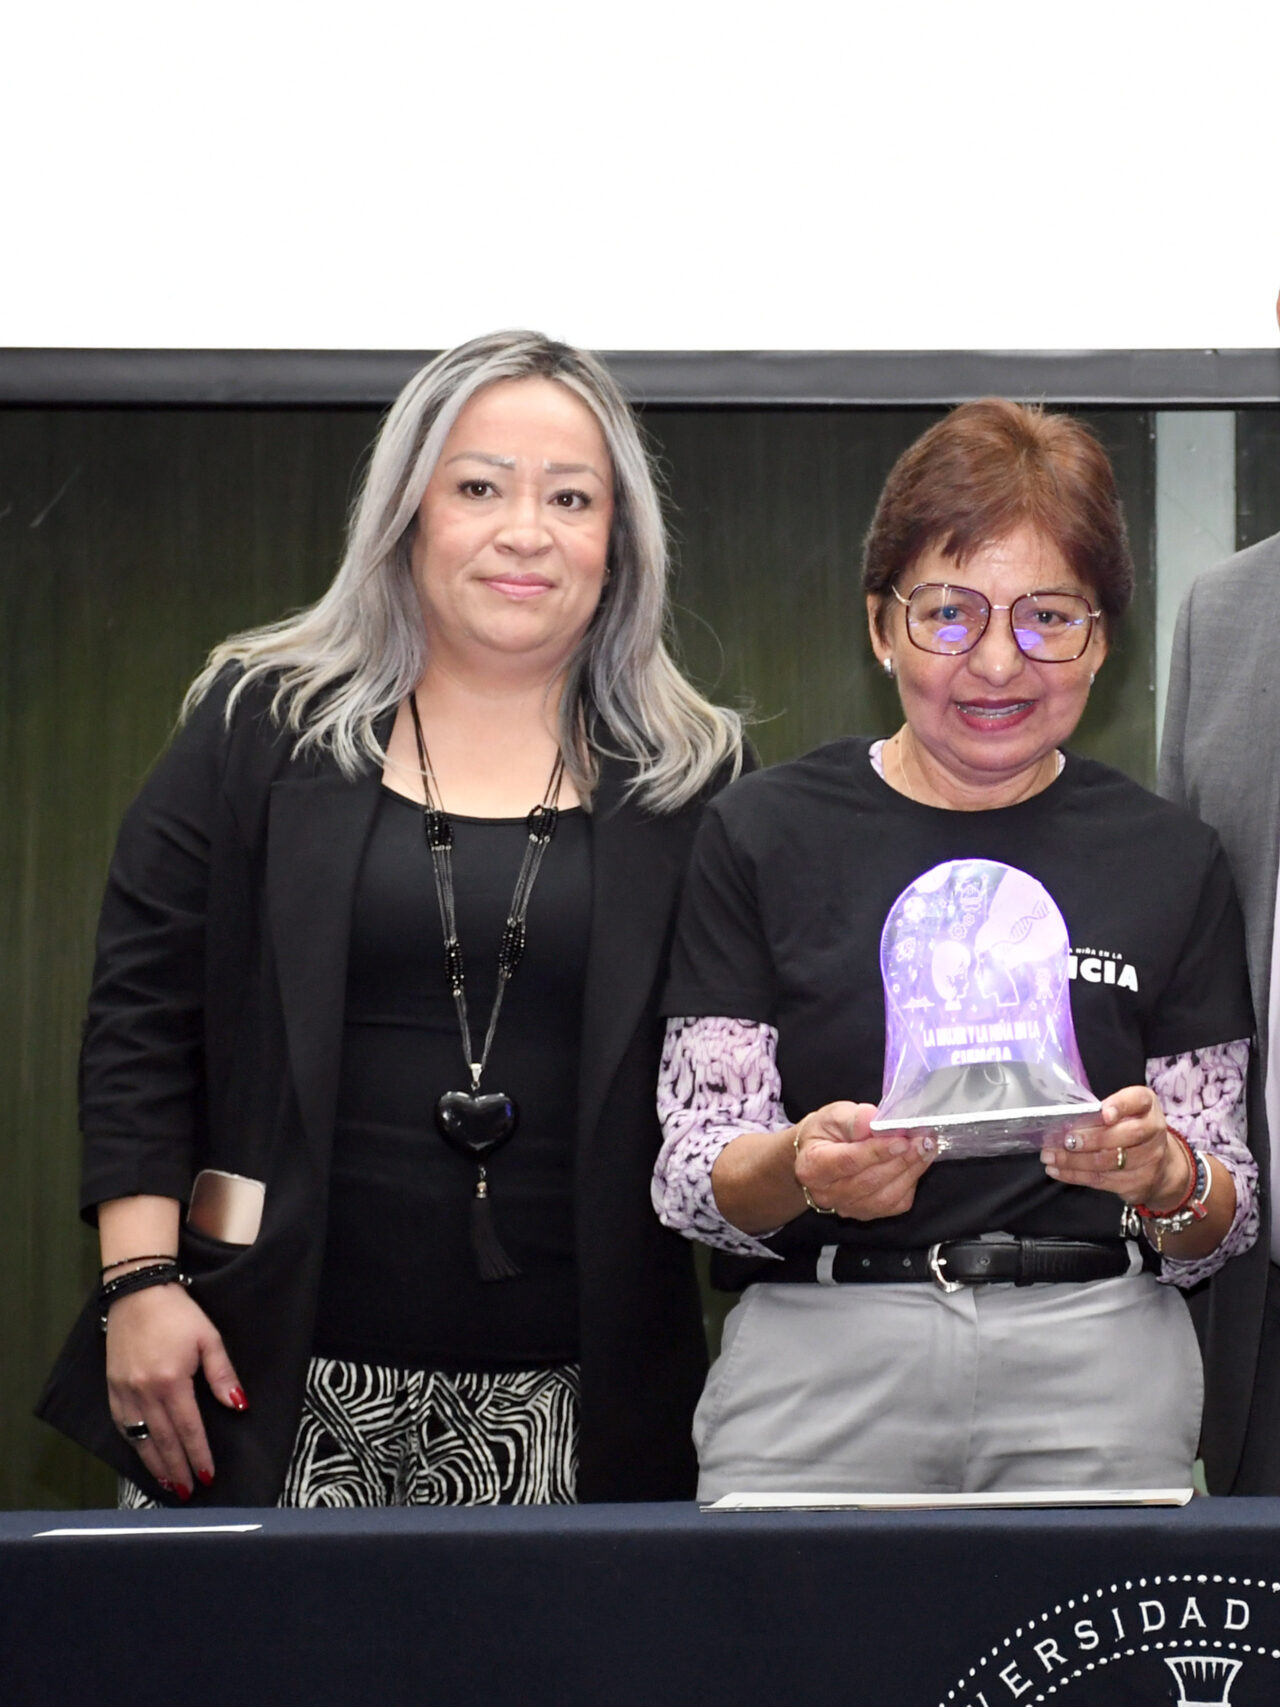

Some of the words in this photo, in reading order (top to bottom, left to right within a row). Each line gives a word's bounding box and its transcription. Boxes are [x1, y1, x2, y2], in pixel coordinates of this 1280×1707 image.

[1075, 946, 1096, 956] NIÑA
[1098, 950, 1110, 958] EN
[1112, 952, 1122, 960] LA
[923, 1028, 936, 1048] LA
[975, 1024, 989, 1044] LA
[1028, 1020, 1041, 1039] LA
